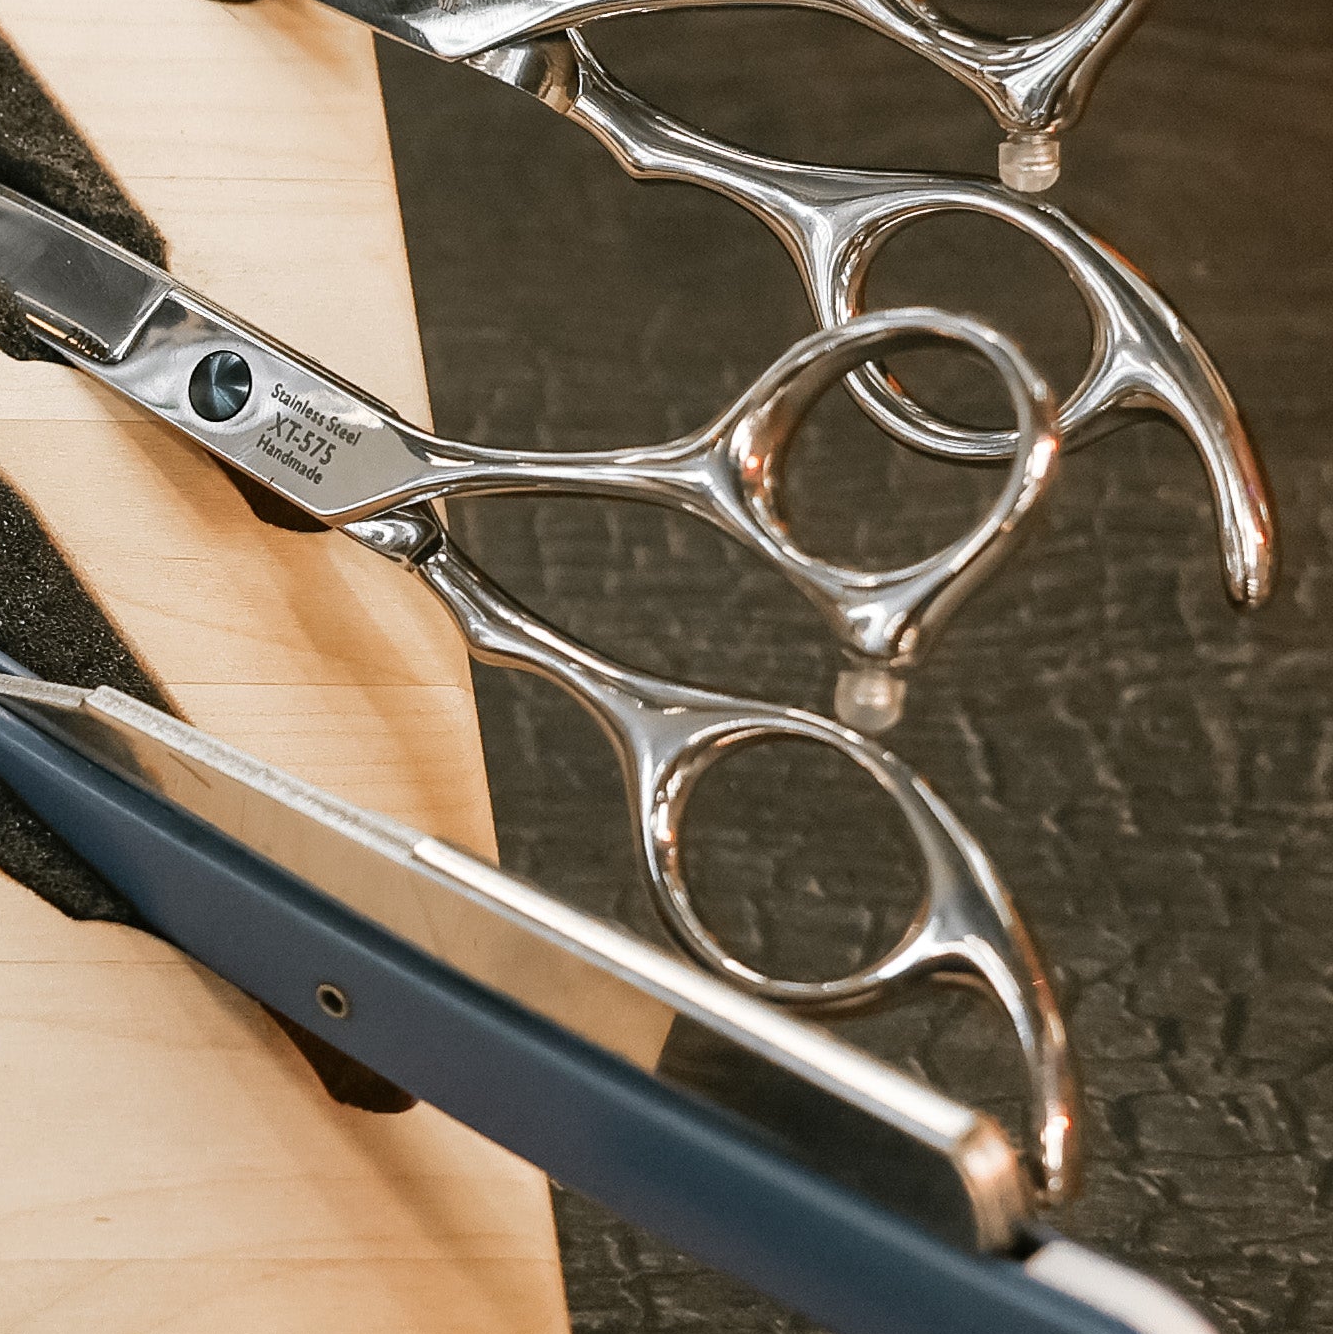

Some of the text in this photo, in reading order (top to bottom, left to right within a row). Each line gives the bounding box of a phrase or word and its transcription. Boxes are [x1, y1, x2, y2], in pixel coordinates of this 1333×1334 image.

[267, 411, 337, 466] XT-575
[270, 383, 362, 447] Stainless Steel
[256, 434, 323, 485] Handmade
